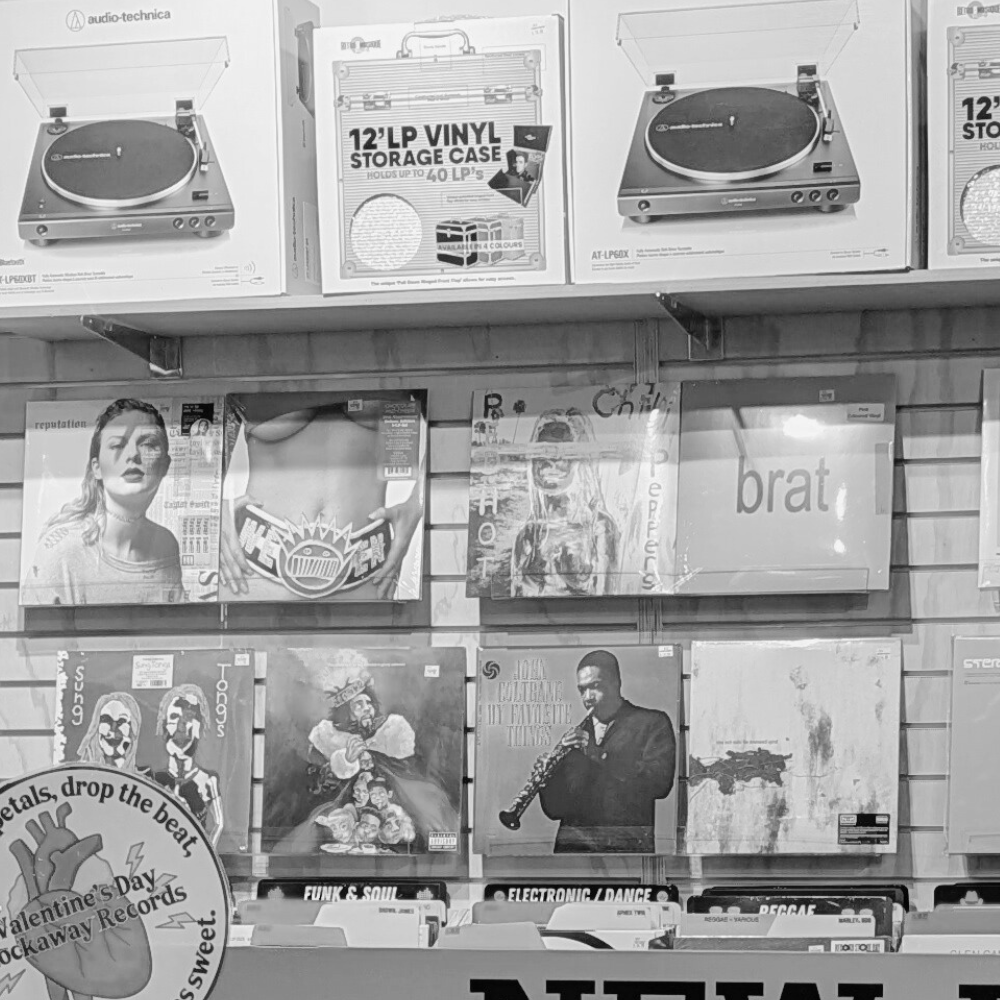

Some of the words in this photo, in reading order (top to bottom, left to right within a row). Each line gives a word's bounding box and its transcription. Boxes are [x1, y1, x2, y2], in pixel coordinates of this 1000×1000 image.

[87, 9, 171, 25] audio-technica
[424, 121, 502, 147] VINYL
[350, 149, 444, 169] STORAGE
[449, 146, 502, 164] CASE
[366, 169, 397, 179] HOLDS
[399, 169, 411, 179] UP
[412, 169, 424, 178] TO
[426, 168, 448, 182] 40
[34, 418, 88, 431] reputation
[736, 456, 830, 514] brat
[71, 665, 85, 726] Sung
[216, 663, 232, 737] Tongs
[61, 776, 115, 804] drop
[119, 782, 154, 814] the
[152, 802, 199, 859] beat,
[113, 868, 157, 897] Day
[303, 885, 344, 901] FUNK
[345, 885, 359, 901] &
[362, 885, 399, 901] SOUL
[507, 887, 592, 902] ELECTRONIC
[604, 888, 652, 902] DANCE
[99, 884, 188, 933] Records
[190, 908, 218, 990] sweet.
